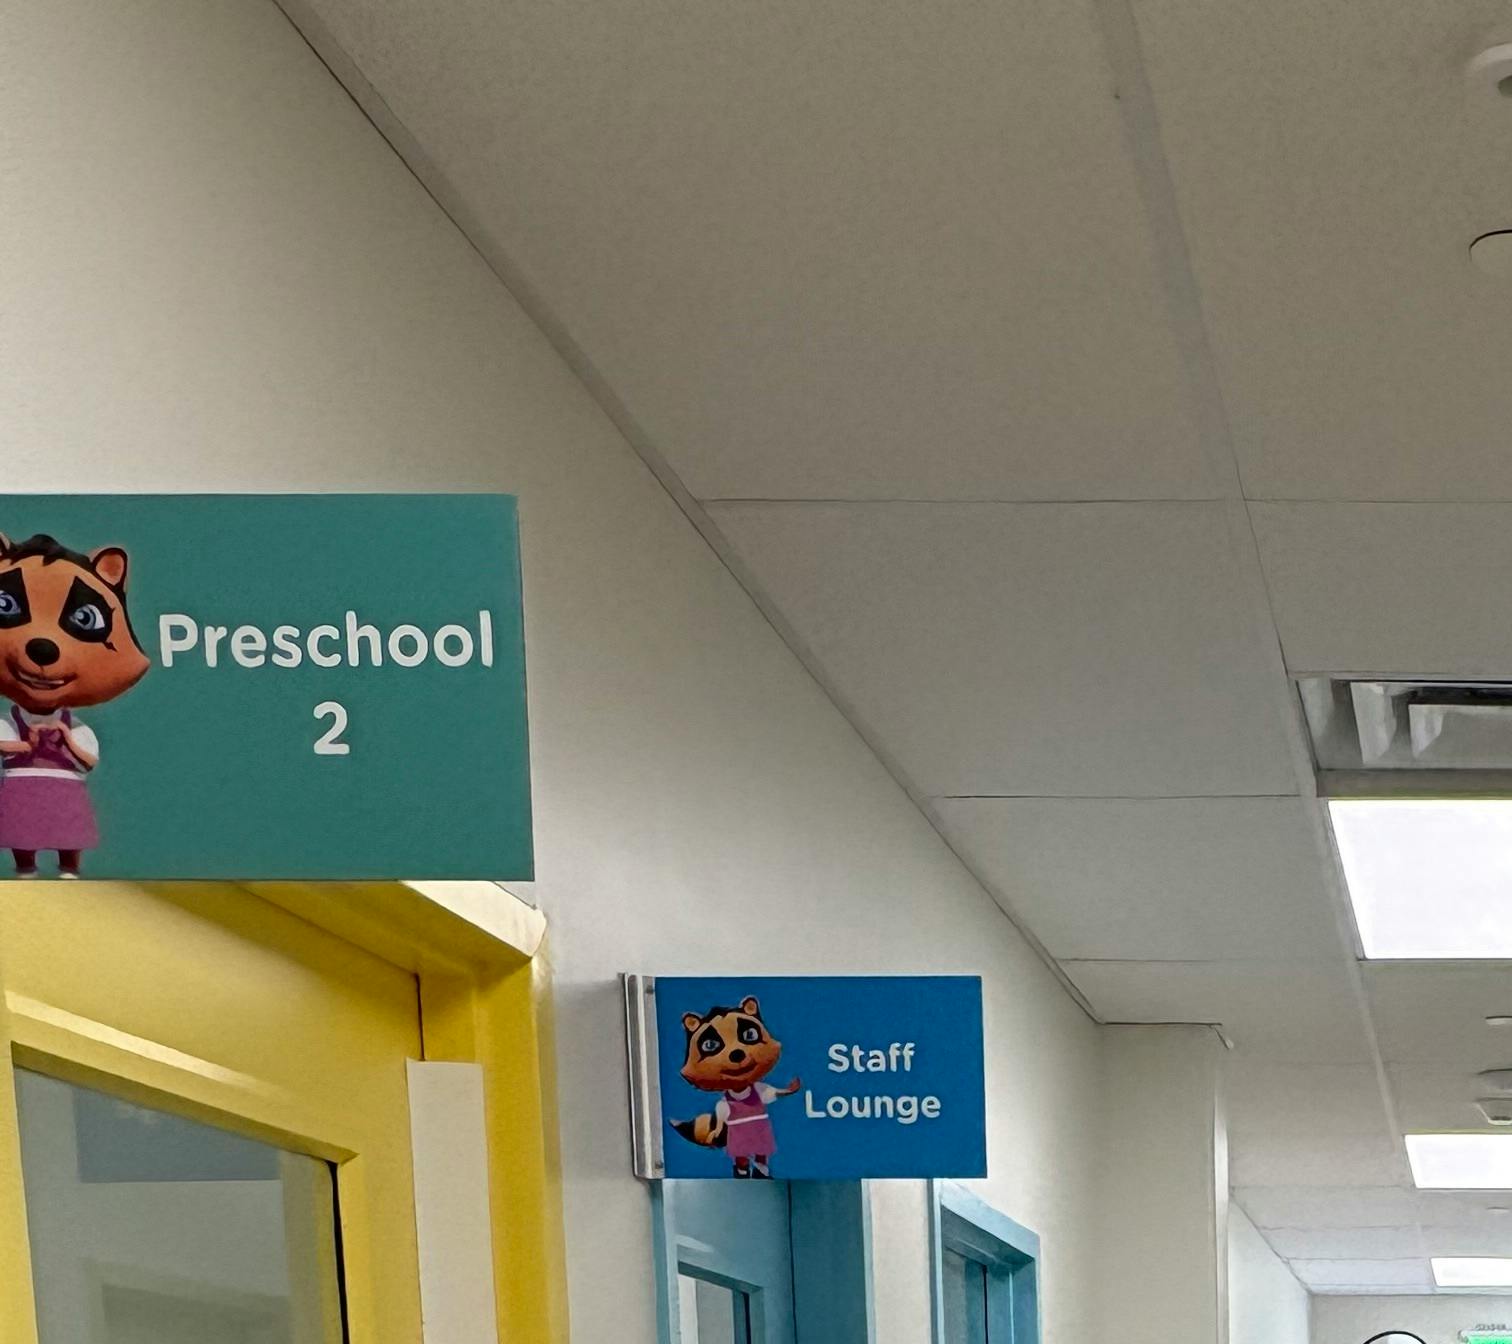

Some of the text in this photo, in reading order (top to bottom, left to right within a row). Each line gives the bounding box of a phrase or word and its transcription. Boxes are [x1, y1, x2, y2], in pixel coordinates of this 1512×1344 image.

[159, 610, 494, 668] Preschool
[313, 701, 350, 755] 2
[828, 1042, 915, 1073] Staff
[805, 1090, 942, 1124] Lounge
